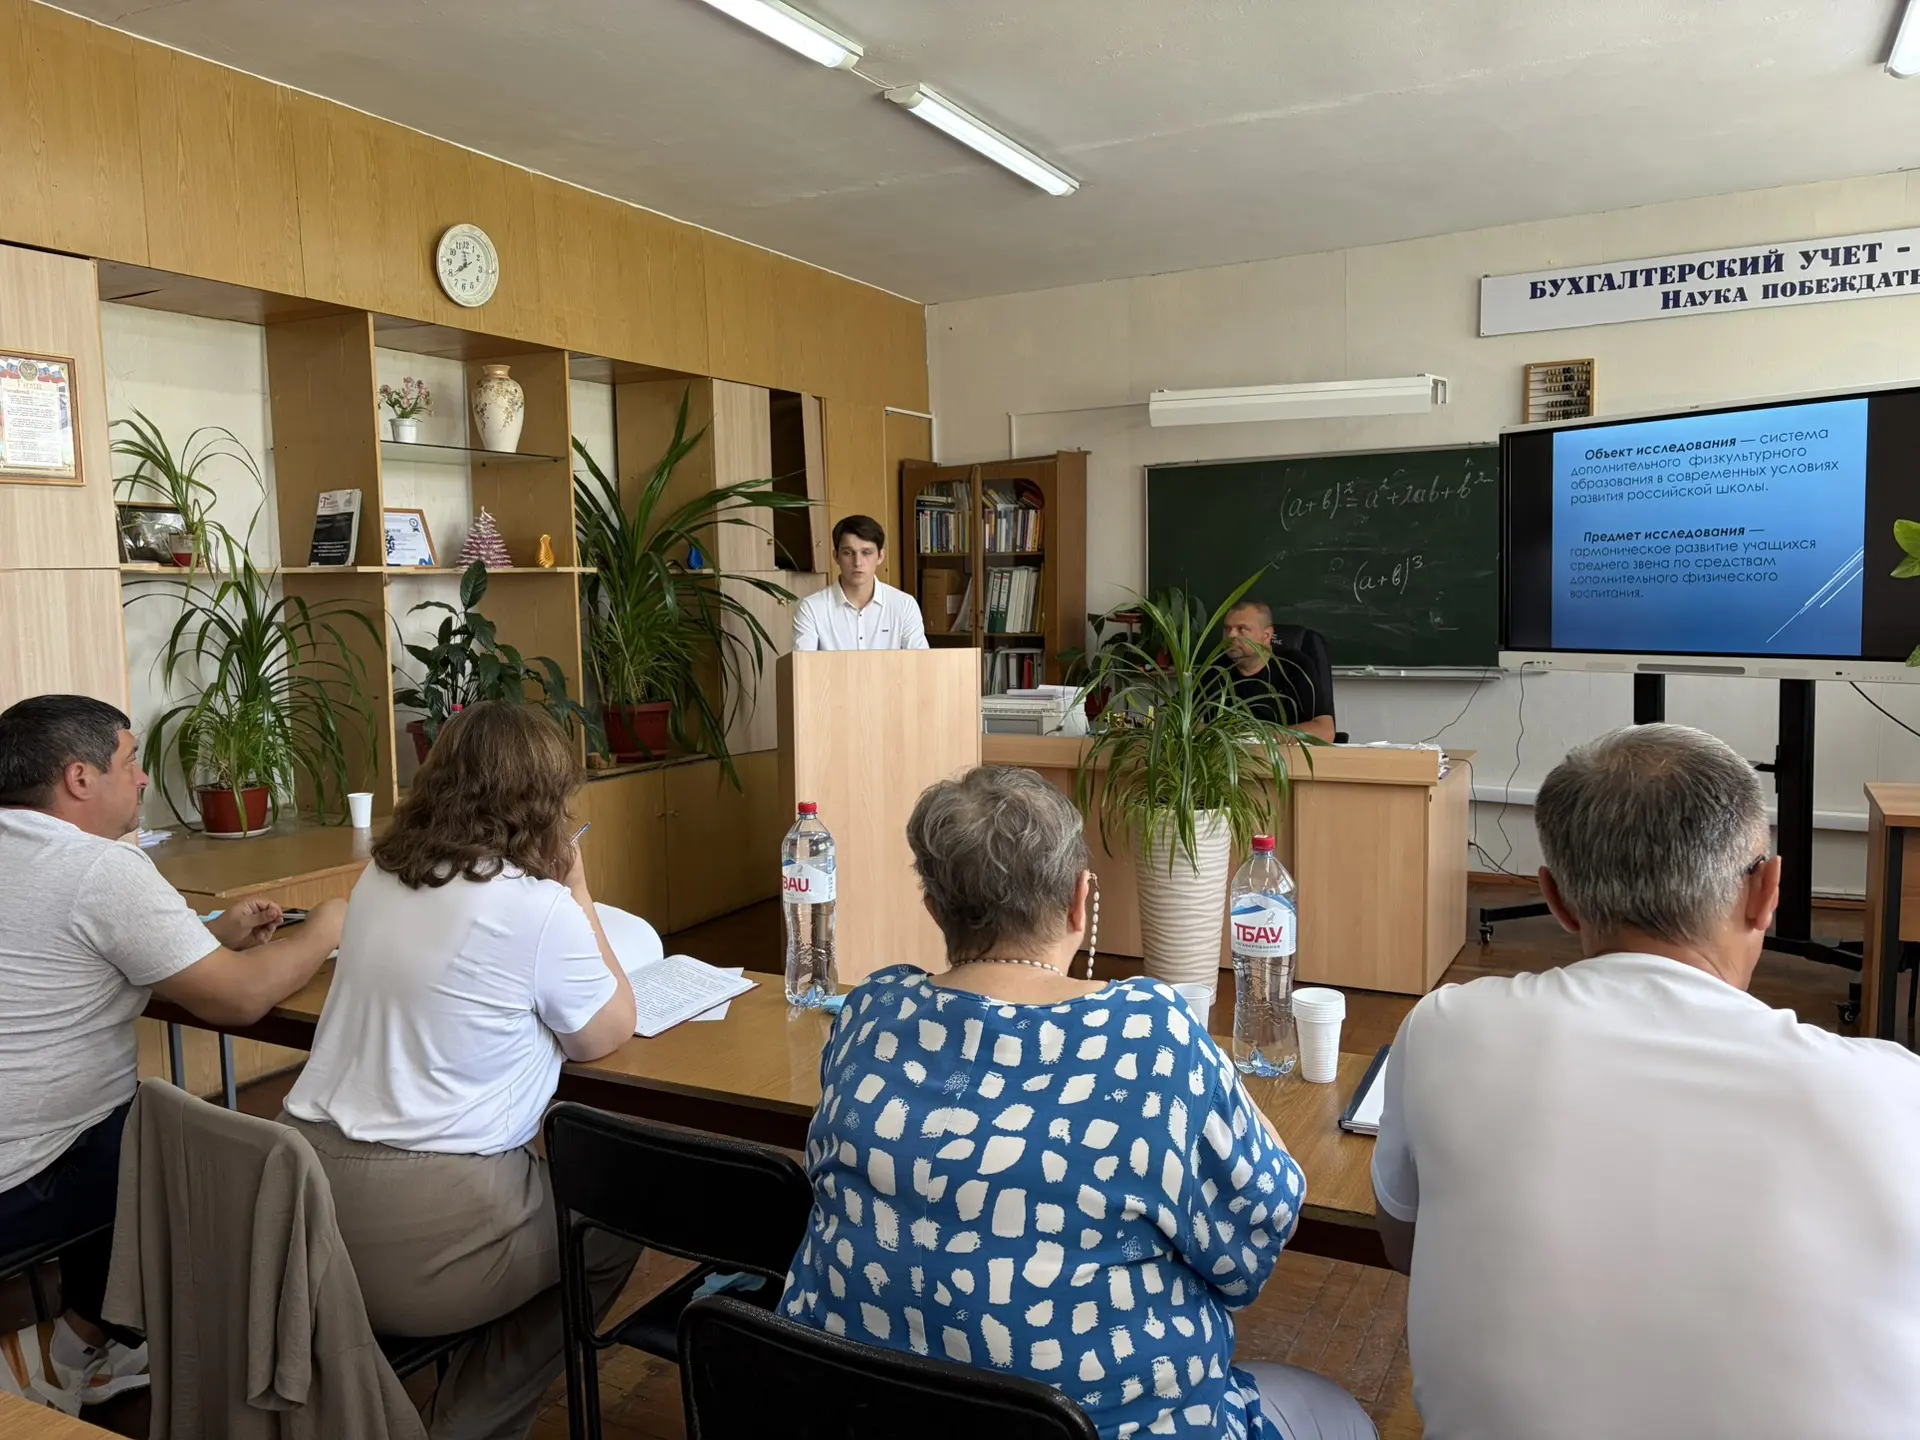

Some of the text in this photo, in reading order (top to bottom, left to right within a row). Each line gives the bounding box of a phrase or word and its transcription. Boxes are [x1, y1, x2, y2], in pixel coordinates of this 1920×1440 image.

[1529, 248, 1785, 300] БУХГАЛТЕРСКИЙ
[1799, 242, 1883, 270] УЧЕТ
[1660, 286, 1749, 310] НАУКА
[1584, 446, 1633, 461] Объект
[1636, 437, 1737, 456] исследования
[1759, 428, 1829, 445] система
[1570, 446, 1808, 477] дополнительного физкультурного
[1570, 460, 1840, 492] образования в современных условиях
[1570, 482, 1769, 506] развития российской школы.
[1583, 531, 1642, 544] Предмет
[1644, 526, 1746, 540] исследования
[1570, 538, 1817, 559] гармоническое развитие учащихся
[1570, 556, 1777, 572] среднего звена по средствам
[1569, 570, 1779, 586] дополнительного физического
[1570, 588, 1644, 600] воспитания.
